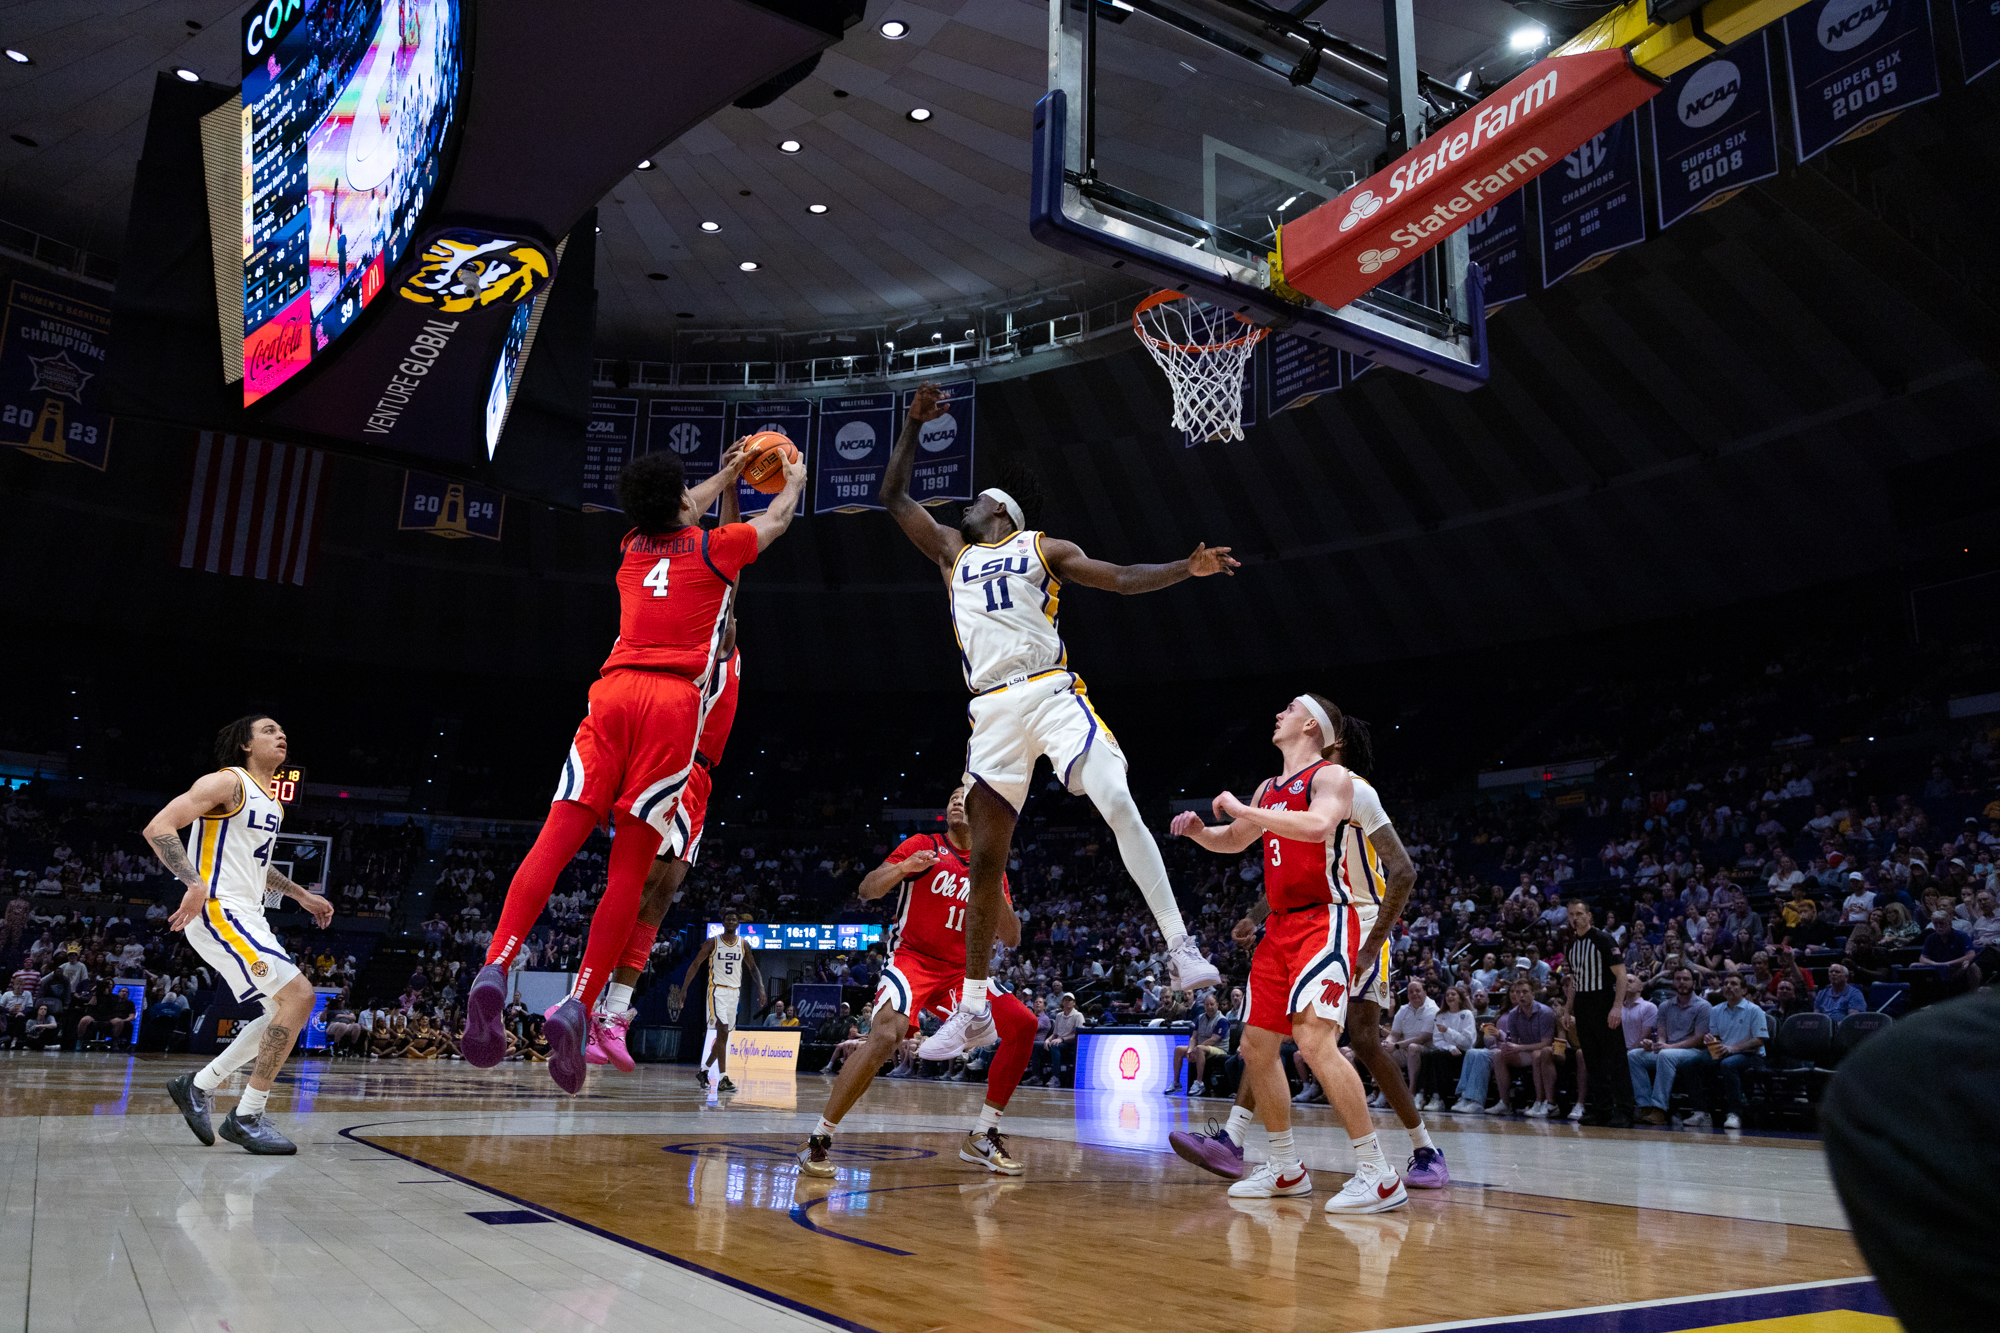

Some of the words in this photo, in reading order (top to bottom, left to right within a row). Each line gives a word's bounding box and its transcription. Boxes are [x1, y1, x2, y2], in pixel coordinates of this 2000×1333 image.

[1827, 0, 1890, 44] NCAA
[1823, 66, 1871, 100] SUPER
[1876, 50, 1901, 73] SIX
[1685, 79, 1740, 120] NCAA
[1832, 71, 1898, 121] 2009
[1681, 144, 1722, 173] SUPER
[1725, 130, 1747, 150] SIX
[1688, 149, 1744, 192] 2008
[1562, 170, 1615, 204] CHAMPIONS
[20, 291, 64, 312] WOMEN'S
[341, 298, 354, 323] 39
[40, 319, 93, 344] NATIONAL
[363, 375, 421, 434] VENTURE
[399, 319, 460, 377] GLOBAL
[840, 399, 874, 407] VOLLEYBALL
[2, 404, 34, 429] 20
[68, 421, 99, 445] 23
[668, 422, 702, 455] SEC
[839, 439, 874, 451] NCAA
[922, 429, 955, 444] NCAA
[830, 474, 852, 484] FINAL
[854, 473, 876, 482] FOUR
[914, 467, 935, 477] FINAL
[938, 464, 958, 473] FOUR
[922, 475, 950, 491] 1991
[414, 494, 440, 513] 20
[836, 484, 868, 498] 1990
[468, 501, 494, 519] 24
[642, 557, 671, 597] 4
[962, 557, 1029, 583] LSU
[983, 575, 1014, 613] 11
[1009, 675, 1026, 686] LSU
[247, 809, 280, 834] LS
[253, 837, 273, 867] 4
[1269, 838, 1282, 867] 3
[931, 870, 957, 898] Ole
[841, 926, 860, 934] LSU
[944, 905, 966, 932] 11
[786, 927, 817, 938] 16:18
[824, 930, 831, 939] 2
[717, 952, 741, 961] LSU
[725, 963, 733, 974] 5
[730, 1043, 738, 1055] The
[767, 1045, 793, 1058] Louisiana
